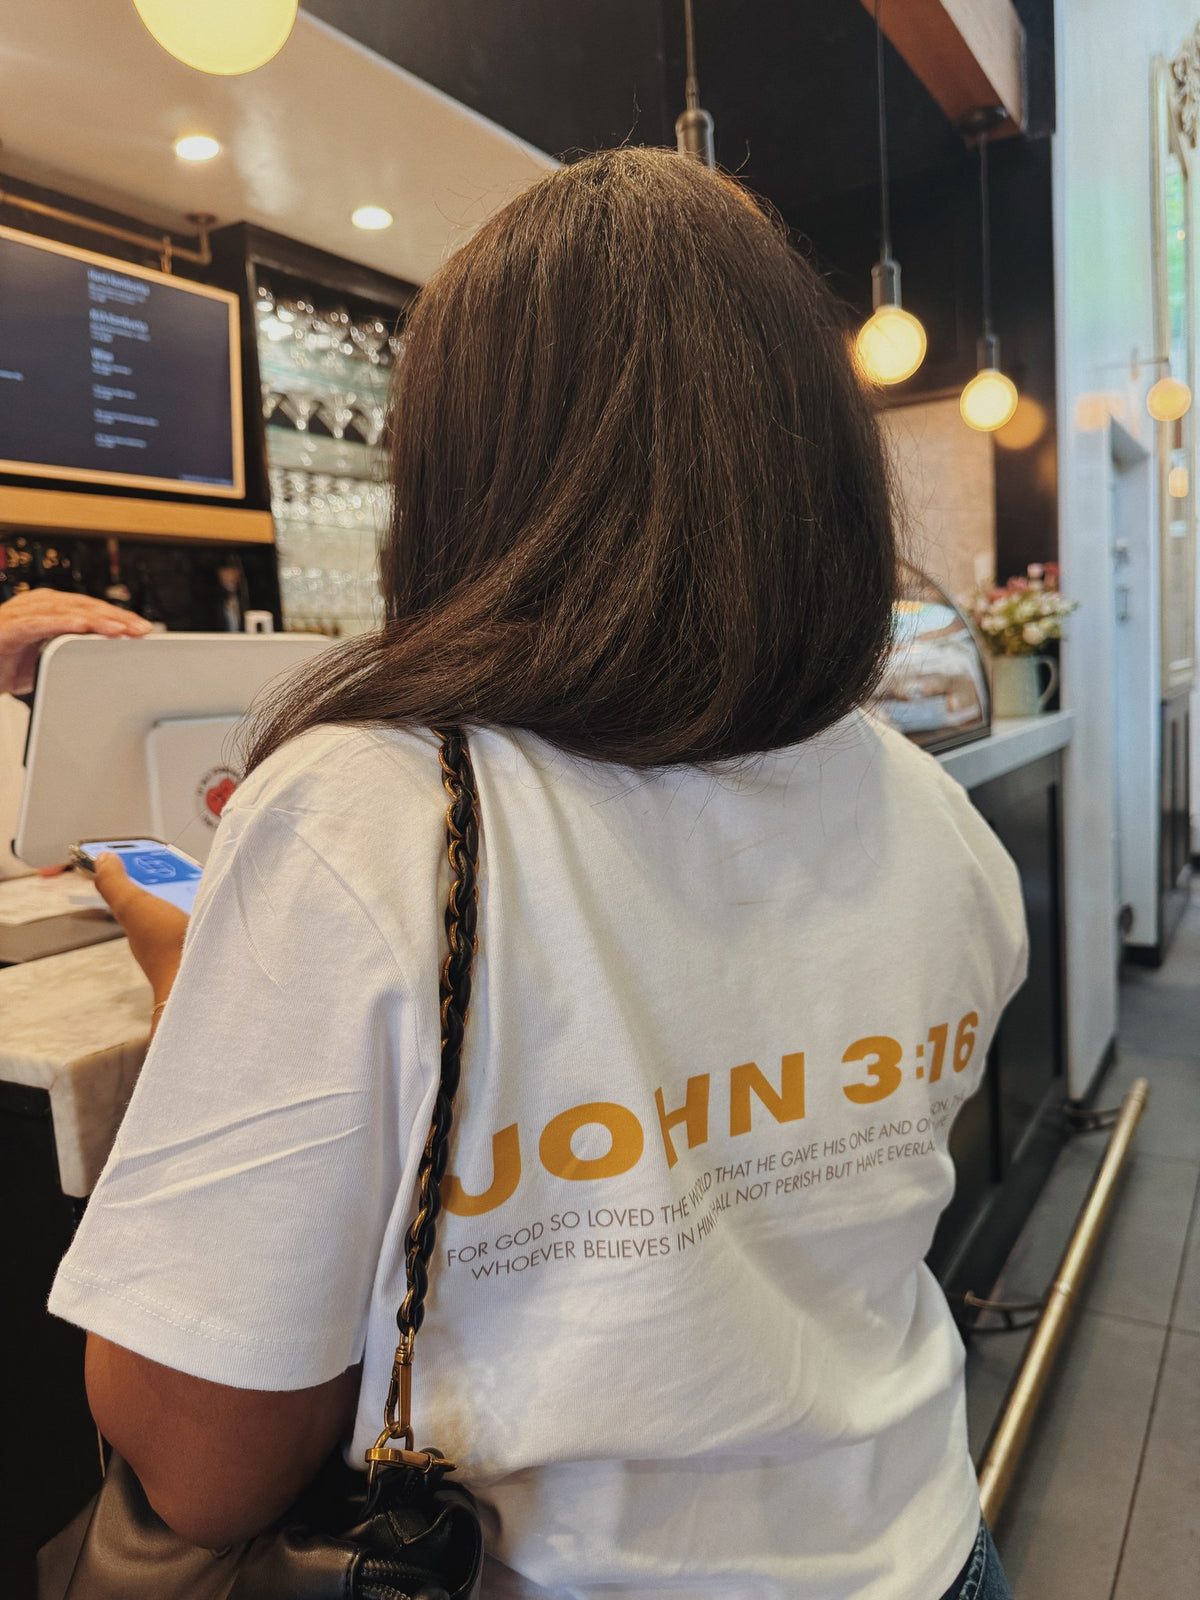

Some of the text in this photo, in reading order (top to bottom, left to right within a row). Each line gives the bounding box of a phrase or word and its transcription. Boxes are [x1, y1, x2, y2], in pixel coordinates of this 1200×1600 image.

[439, 1010, 979, 1218] JOHN 3:16
[447, 1241, 488, 1268] FOR
[495, 1222, 544, 1250] GOD
[550, 1211, 581, 1232] SO
[587, 1208, 655, 1228] LOVED
[660, 1195, 690, 1225] THE
[715, 1160, 753, 1184] THAT
[757, 1154, 777, 1174] HE
[781, 1142, 819, 1168] GAVE
[823, 1137, 847, 1158] HIS
[849, 1126, 876, 1150] ONE
[878, 1119, 913, 1139] AND
[471, 1240, 577, 1281] WHOEVER
[583, 1236, 671, 1260] BELIEVES
[677, 1226, 695, 1252] IN
[735, 1181, 772, 1205] NOT
[775, 1167, 822, 1195] PERISH
[825, 1160, 853, 1181] BUT
[856, 1147, 884, 1175] HAVE
[887, 1139, 936, 1162] EVERLA
